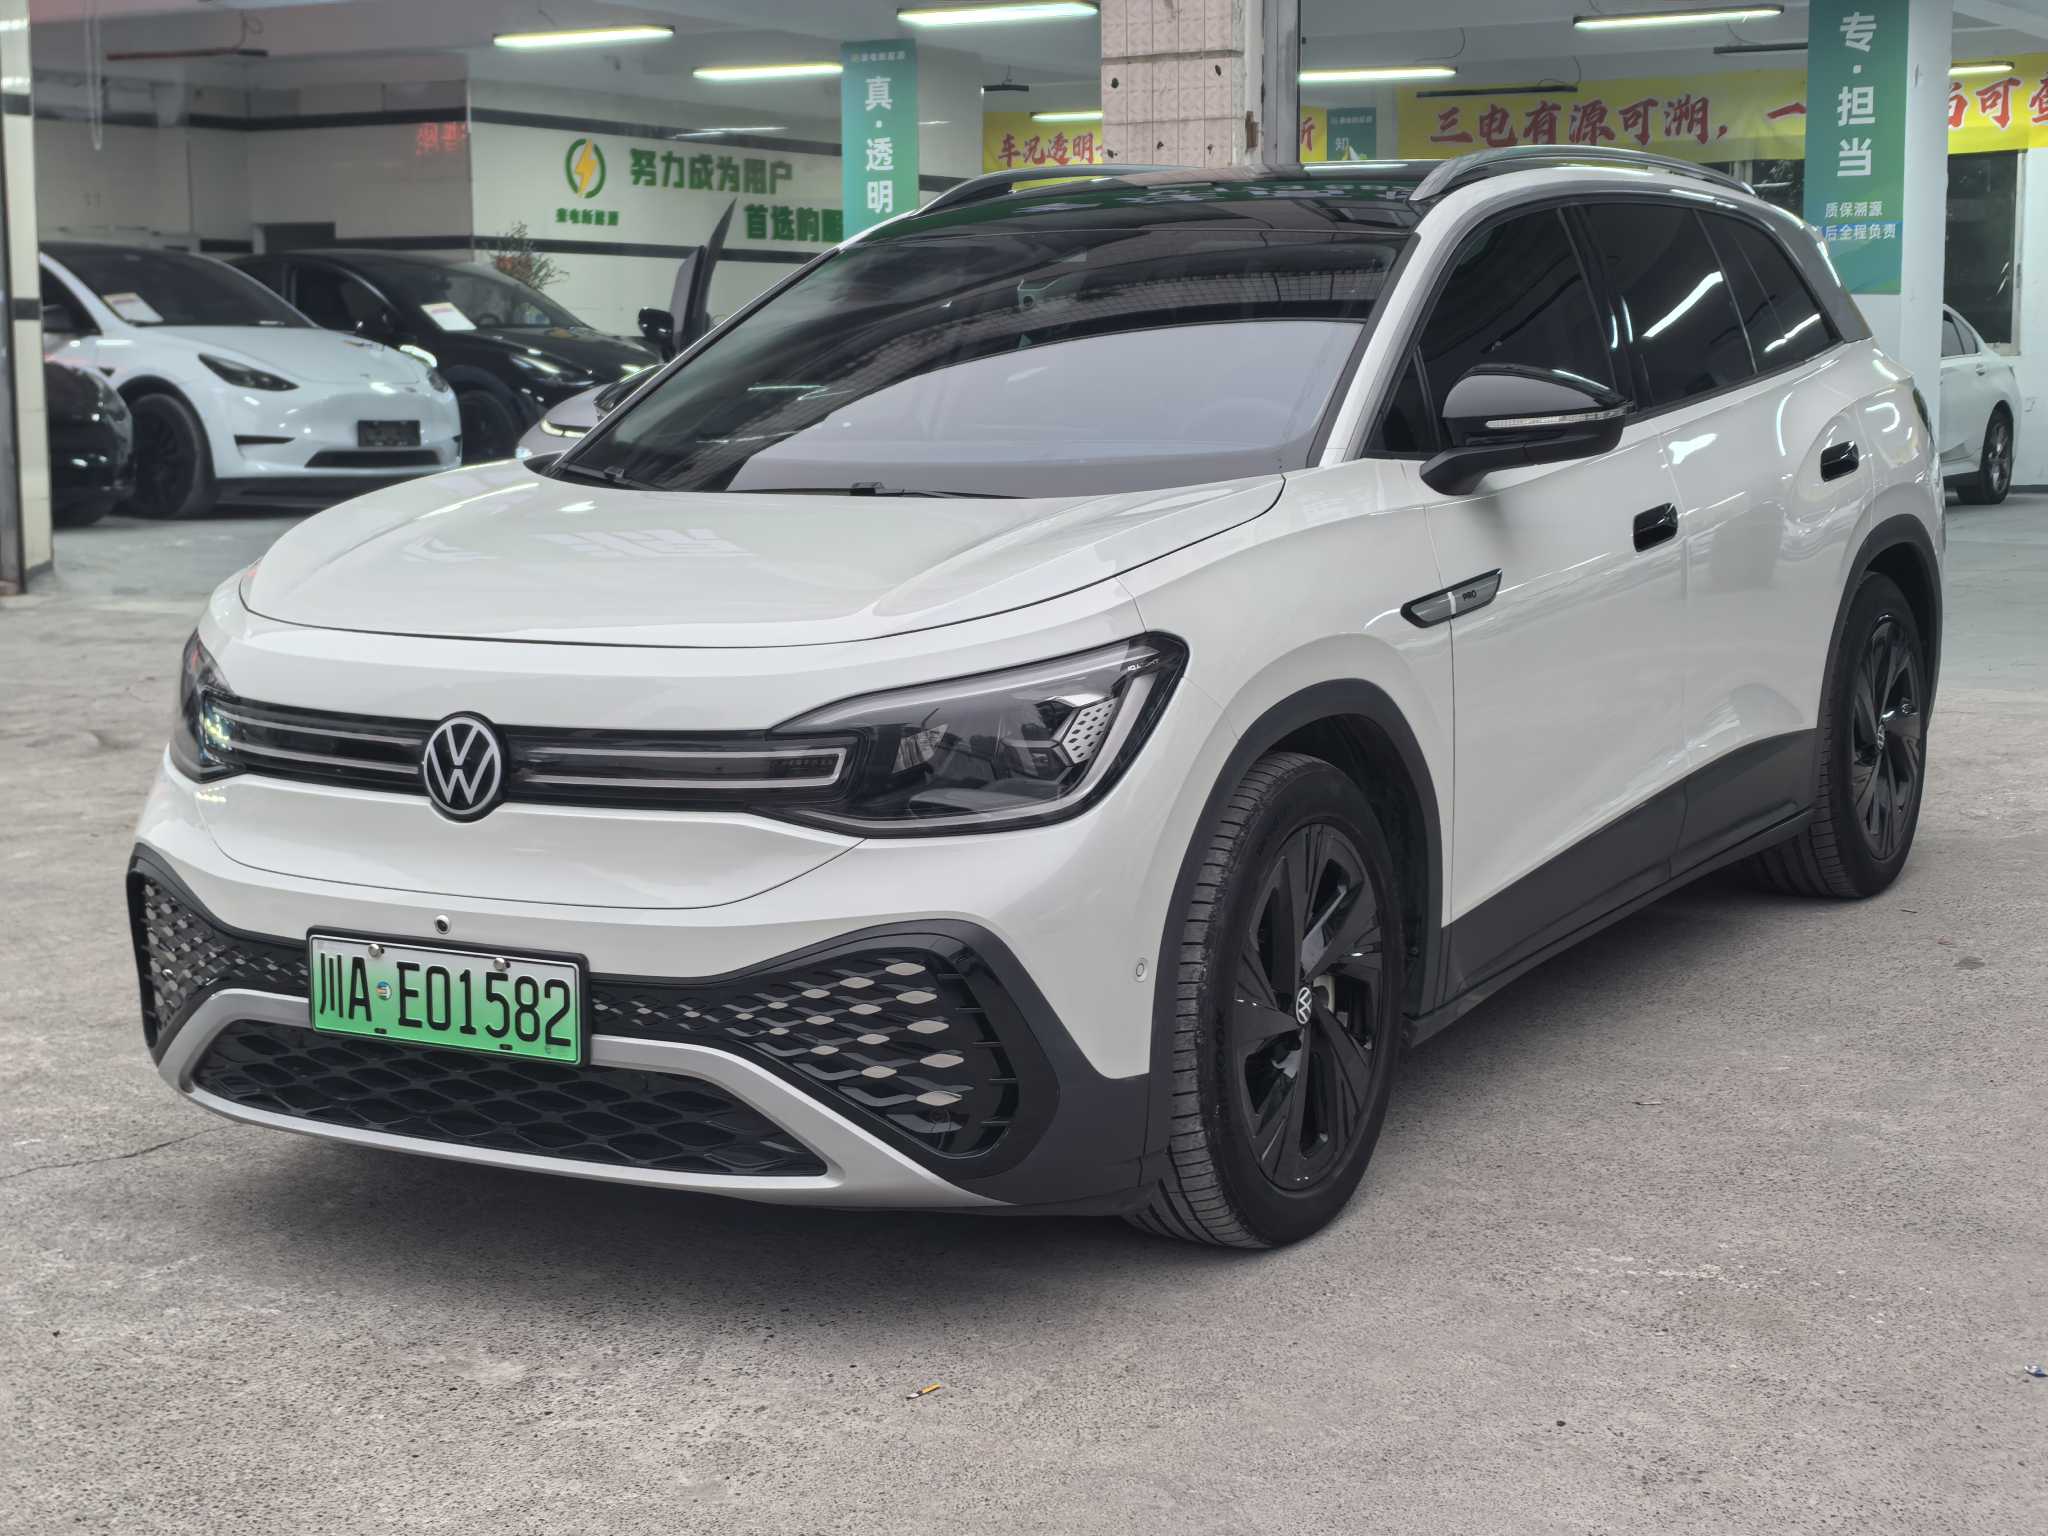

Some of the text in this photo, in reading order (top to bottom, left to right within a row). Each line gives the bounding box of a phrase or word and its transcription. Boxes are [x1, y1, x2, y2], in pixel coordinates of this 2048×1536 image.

[1810, 223, 1896, 240] 后全程负责
[425, 717, 500, 813] VW
